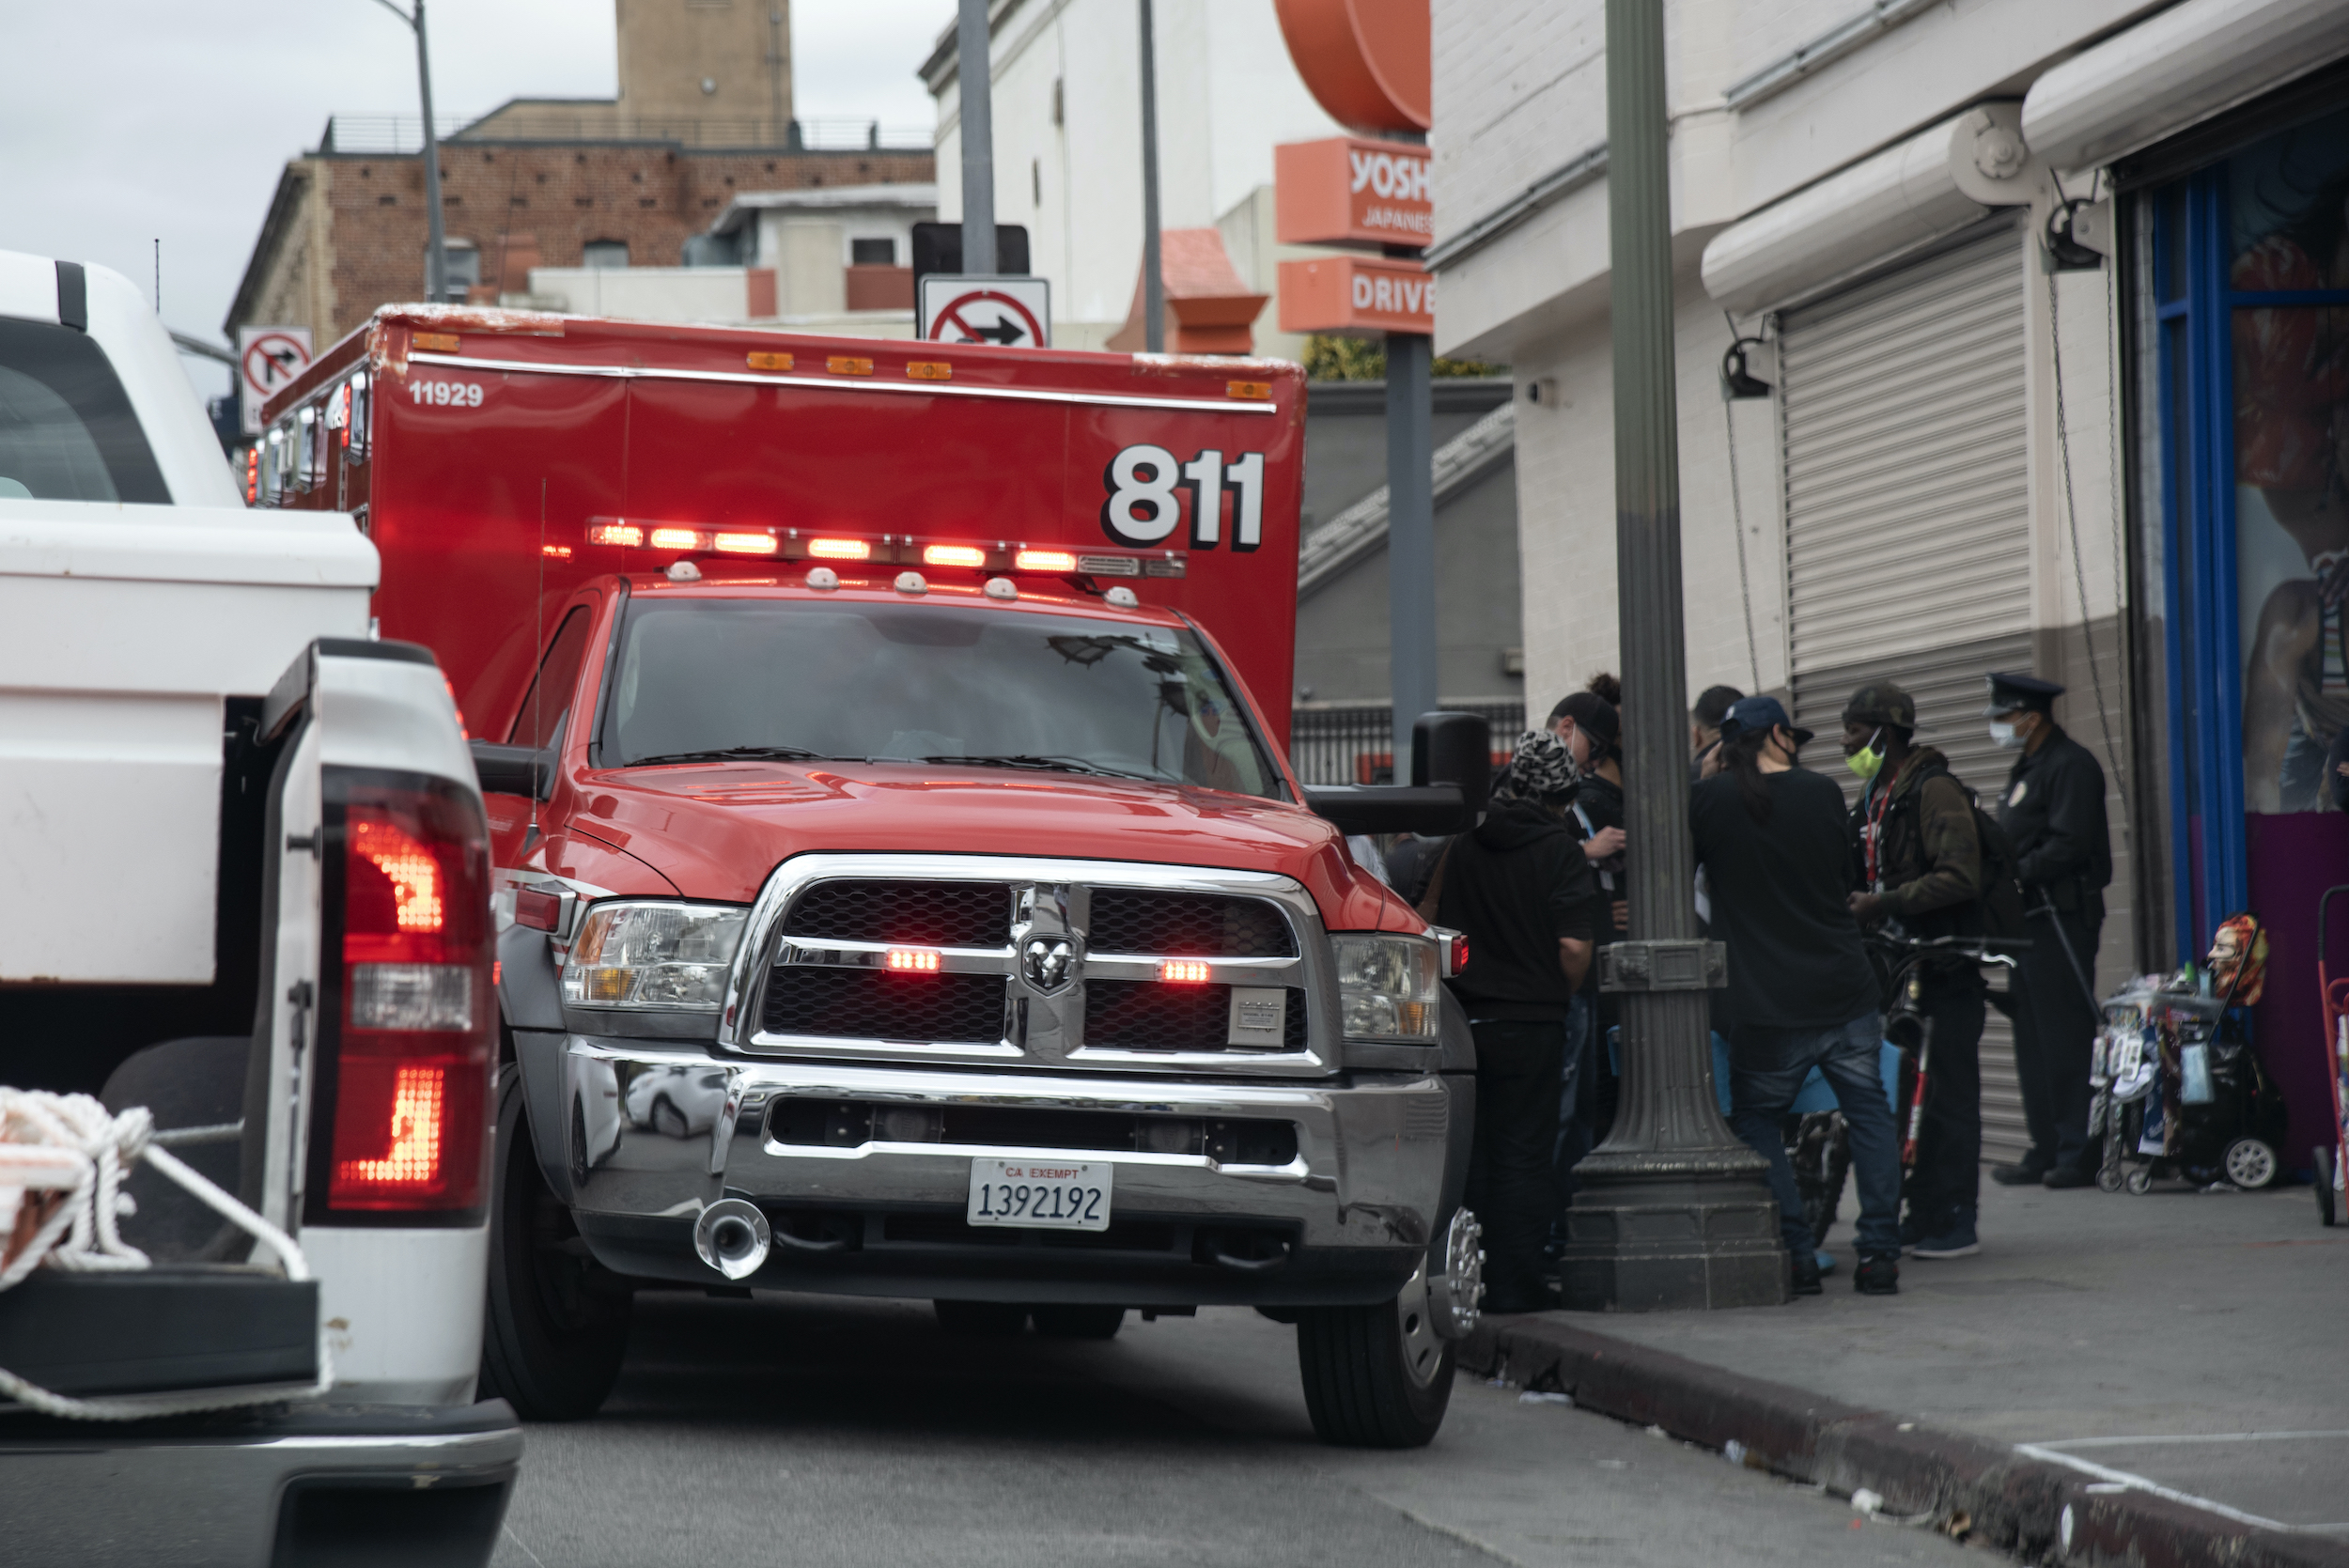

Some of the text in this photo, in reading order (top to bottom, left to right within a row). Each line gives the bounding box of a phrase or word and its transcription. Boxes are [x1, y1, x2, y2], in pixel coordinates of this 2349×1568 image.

[1349, 151, 1432, 201] YOSH
[1352, 273, 1434, 314] DRIVE
[409, 380, 484, 408] 11929
[1101, 443, 1265, 552] 811
[1005, 1167, 1080, 1180] CA EXEMPT
[977, 1184, 1101, 1219] 1392192
